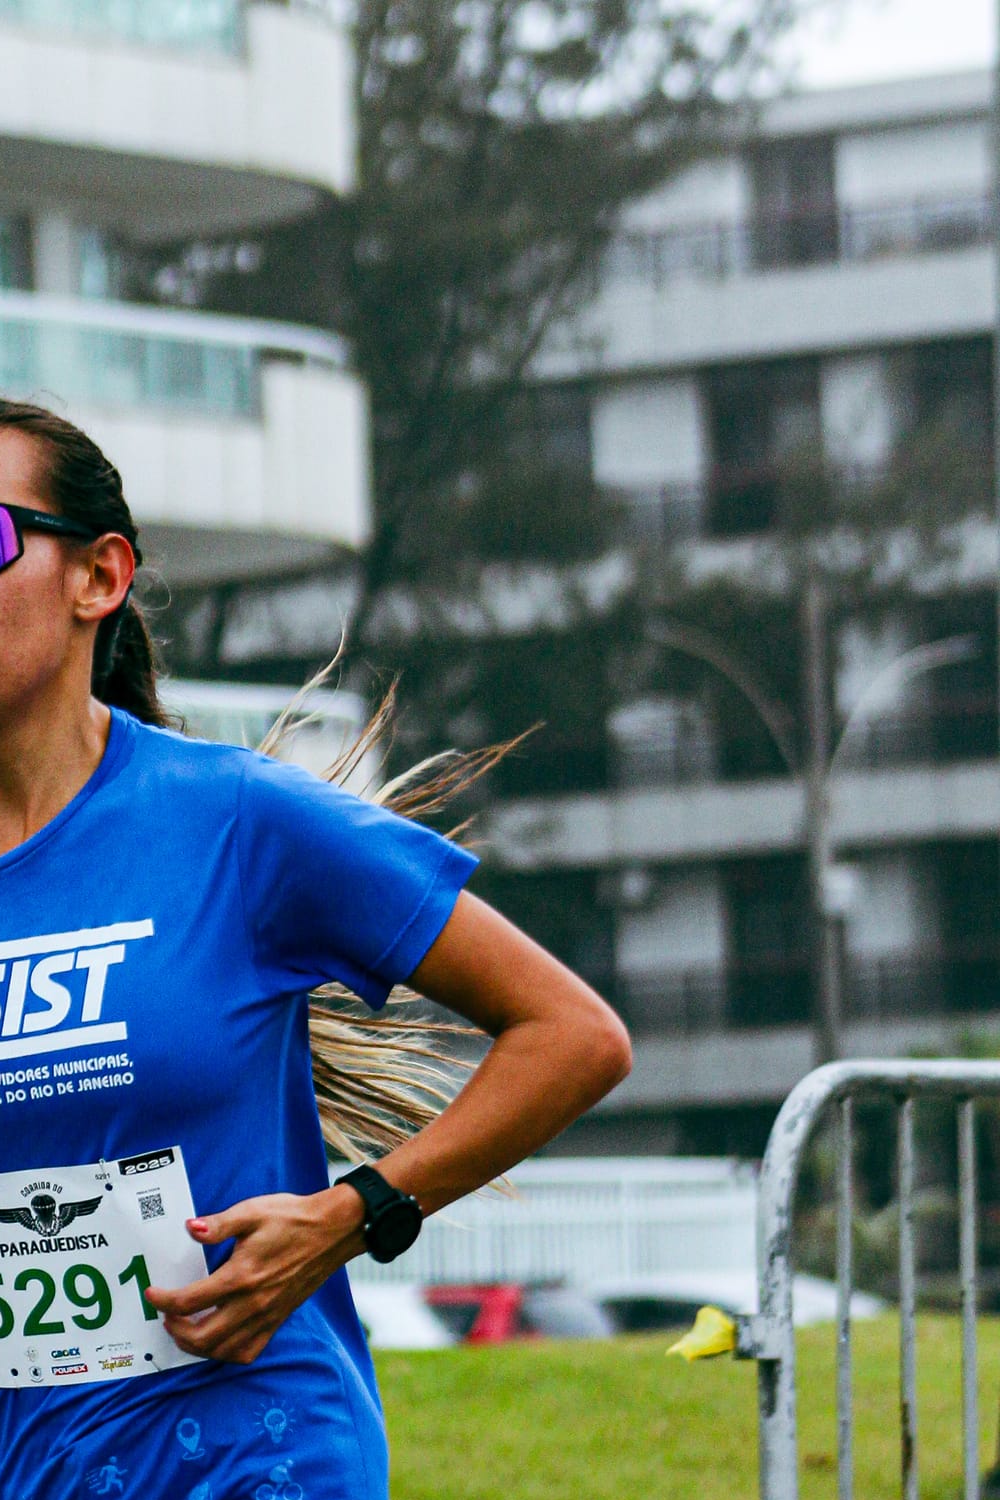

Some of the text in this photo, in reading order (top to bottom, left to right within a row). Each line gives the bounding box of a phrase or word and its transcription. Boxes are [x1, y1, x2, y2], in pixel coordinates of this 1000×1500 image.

[53, 1053, 133, 1077] MUNICIPAIS,
[6, 1090, 26, 1104] DO
[30, 1086, 53, 1100] RIO
[57, 1082, 74, 1095] DE
[77, 1071, 134, 1092] JANEIRO
[124, 1156, 171, 1175] 2025
[20, 1181, 63, 1197] CORRIDA DO
[0, 1233, 109, 1258] PARAQUEDISTA
[53, 1364, 86, 1375] POUPEX
